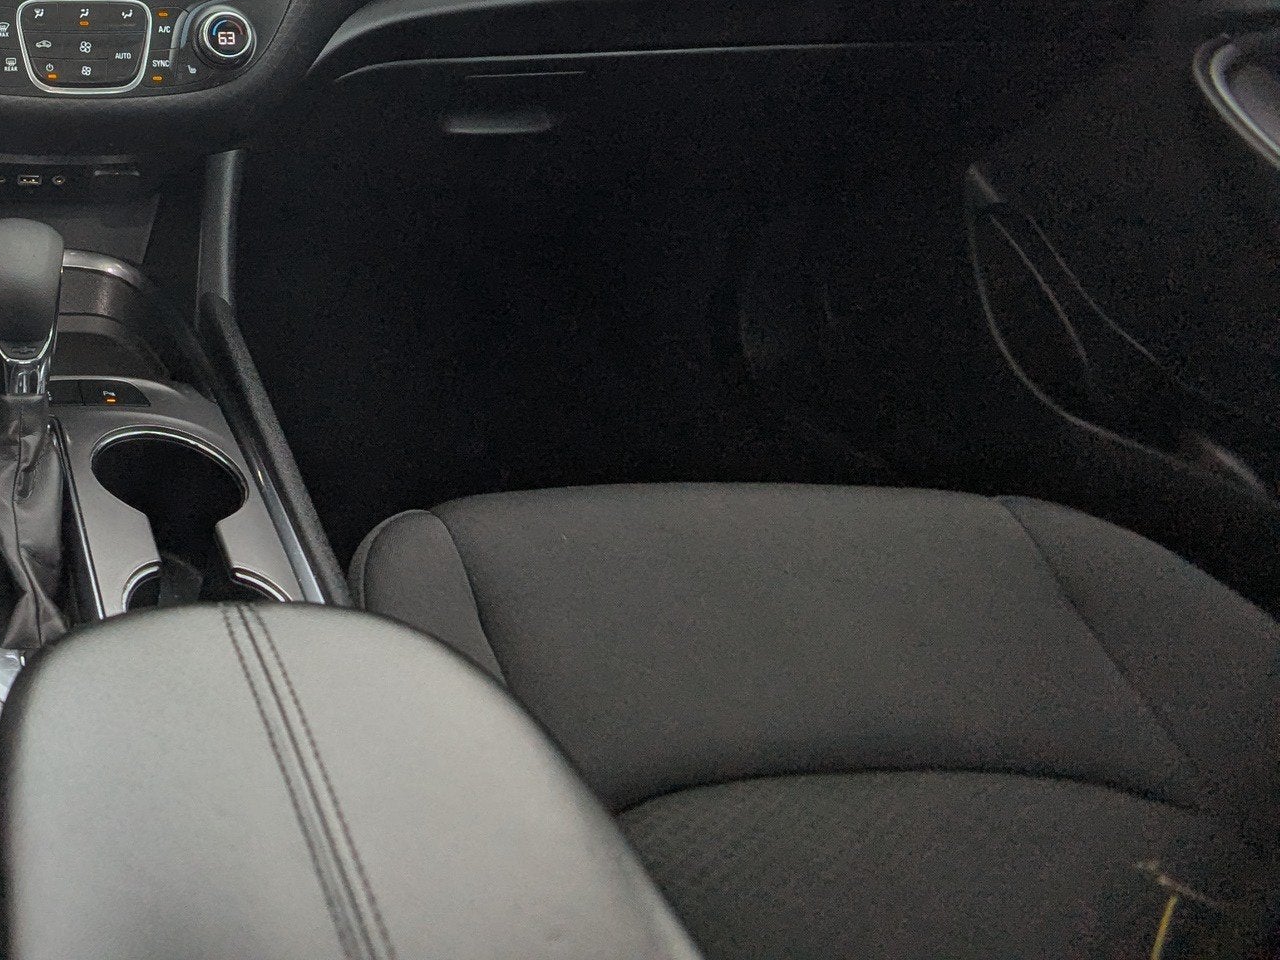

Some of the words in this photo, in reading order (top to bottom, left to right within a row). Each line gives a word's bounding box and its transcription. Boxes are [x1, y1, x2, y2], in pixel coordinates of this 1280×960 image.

[158, 25, 171, 34] A/C
[217, 31, 236, 46] 63
[114, 52, 132, 60] AUTO
[152, 59, 171, 68] SYNC
